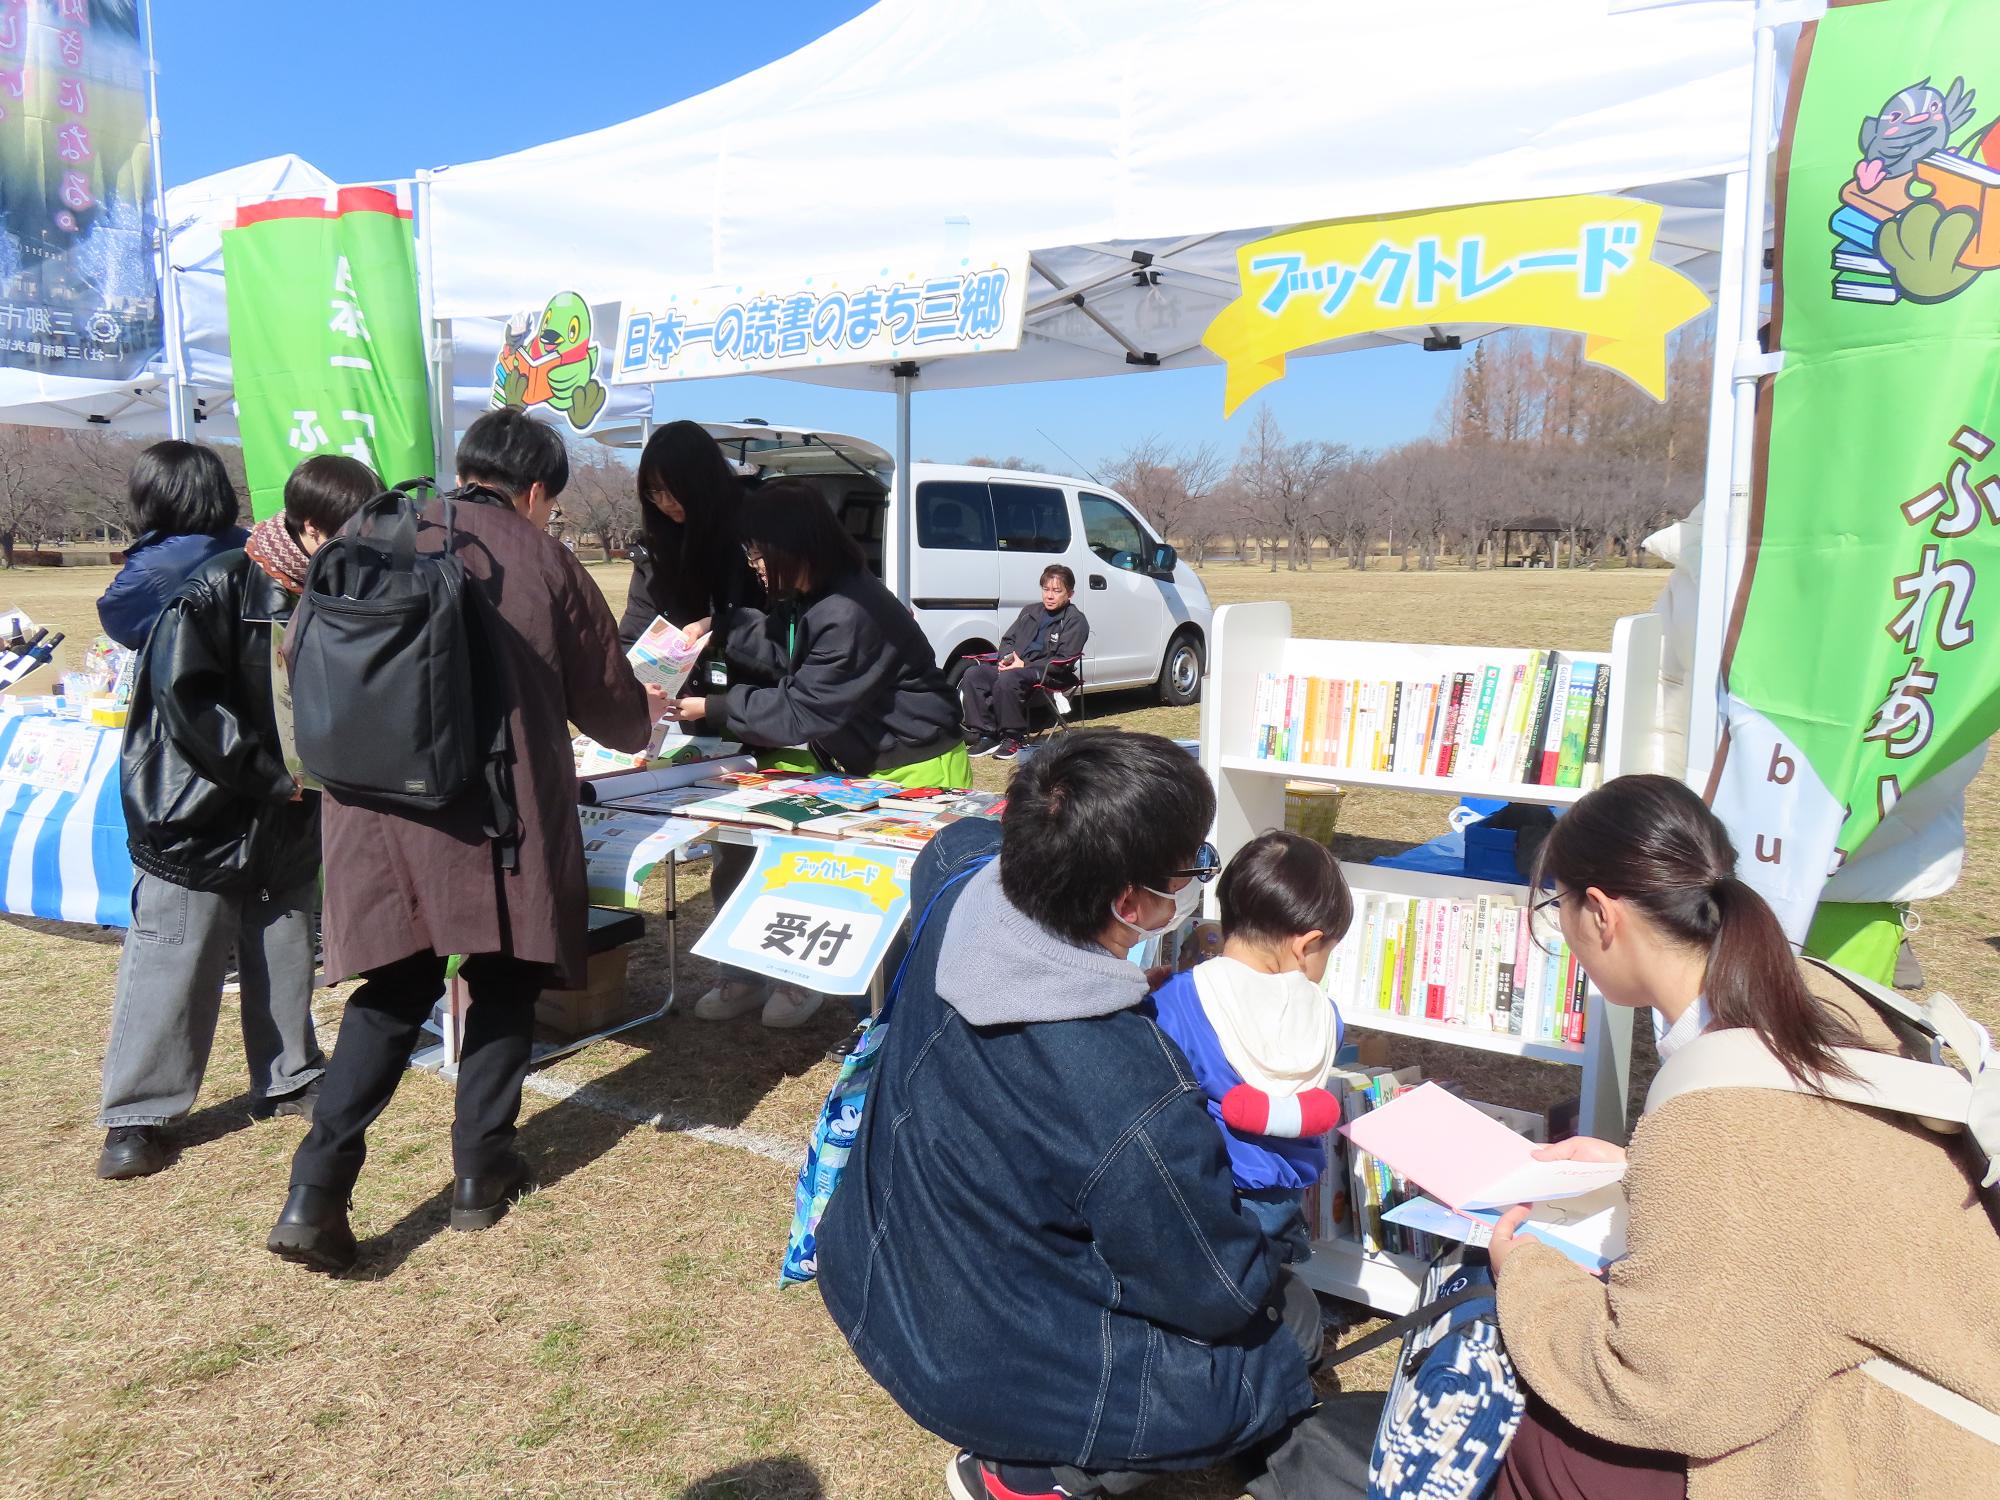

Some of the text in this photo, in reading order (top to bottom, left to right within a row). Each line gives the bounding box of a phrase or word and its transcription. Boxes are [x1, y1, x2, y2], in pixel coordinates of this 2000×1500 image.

[1251, 225, 1638, 315] ブックトレード
[621, 268, 1008, 371] 日本一の読書のまち三郷
[794, 857, 880, 885] ブックトレード
[760, 911, 854, 967] 受付
